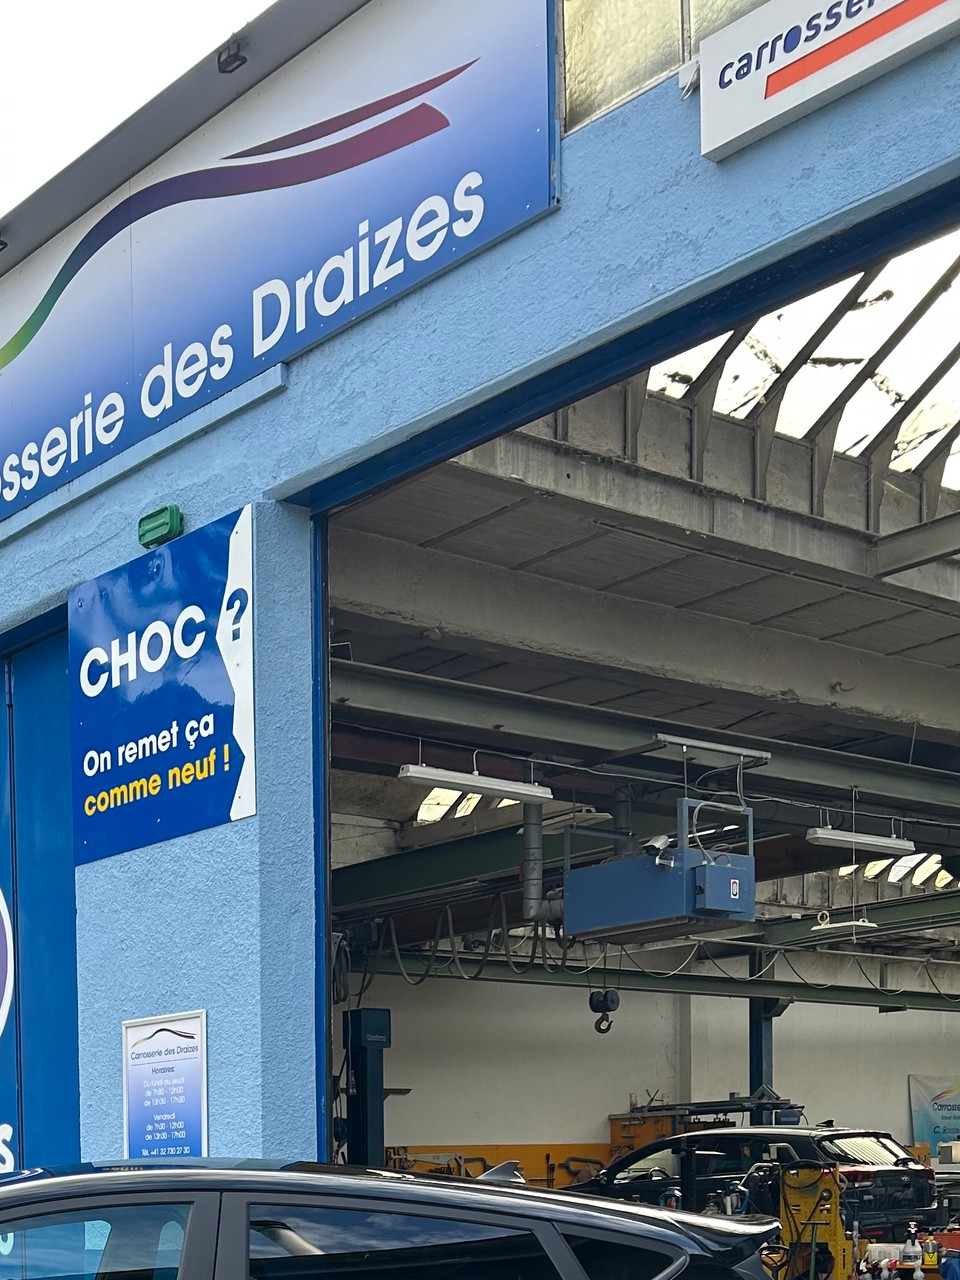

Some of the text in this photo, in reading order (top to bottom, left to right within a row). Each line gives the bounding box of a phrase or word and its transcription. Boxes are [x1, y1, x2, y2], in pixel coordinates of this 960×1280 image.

[140, 324, 235, 420] des
[252, 170, 485, 359] Draizes
[79, 587, 249, 698] CHOC ?
[83, 712, 214, 777] On remet ça
[84, 744, 230, 816] comme neuf !
[131, 1045, 199, 1060] Carrosserie des Draizes
